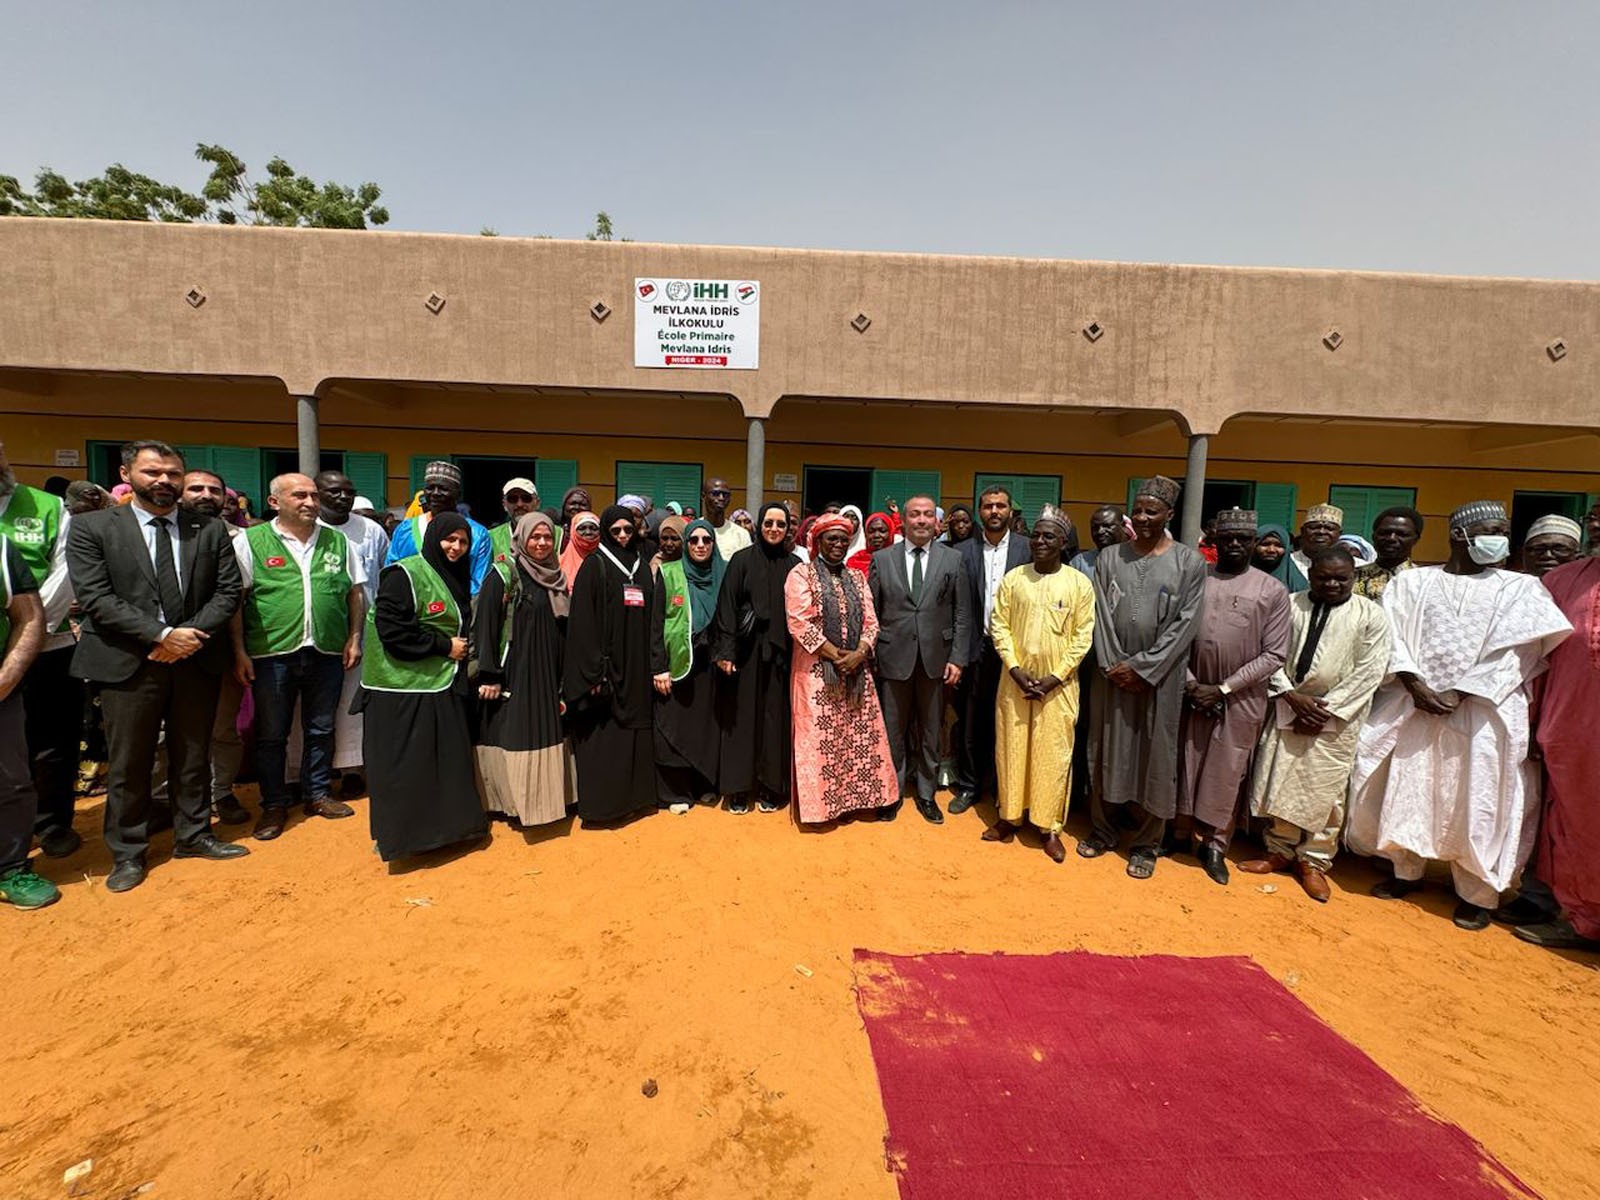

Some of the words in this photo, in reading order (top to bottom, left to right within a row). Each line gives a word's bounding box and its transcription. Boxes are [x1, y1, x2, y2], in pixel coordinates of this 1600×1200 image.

[653, 305, 708, 315] MEVLANA
[710, 305, 740, 316] İDRİS
[668, 317, 724, 328] İLKOKULU
[657, 329, 687, 340] École
[689, 331, 735, 341] Primaire
[660, 343, 705, 353] Mevlana
[708, 344, 732, 354] Idris
